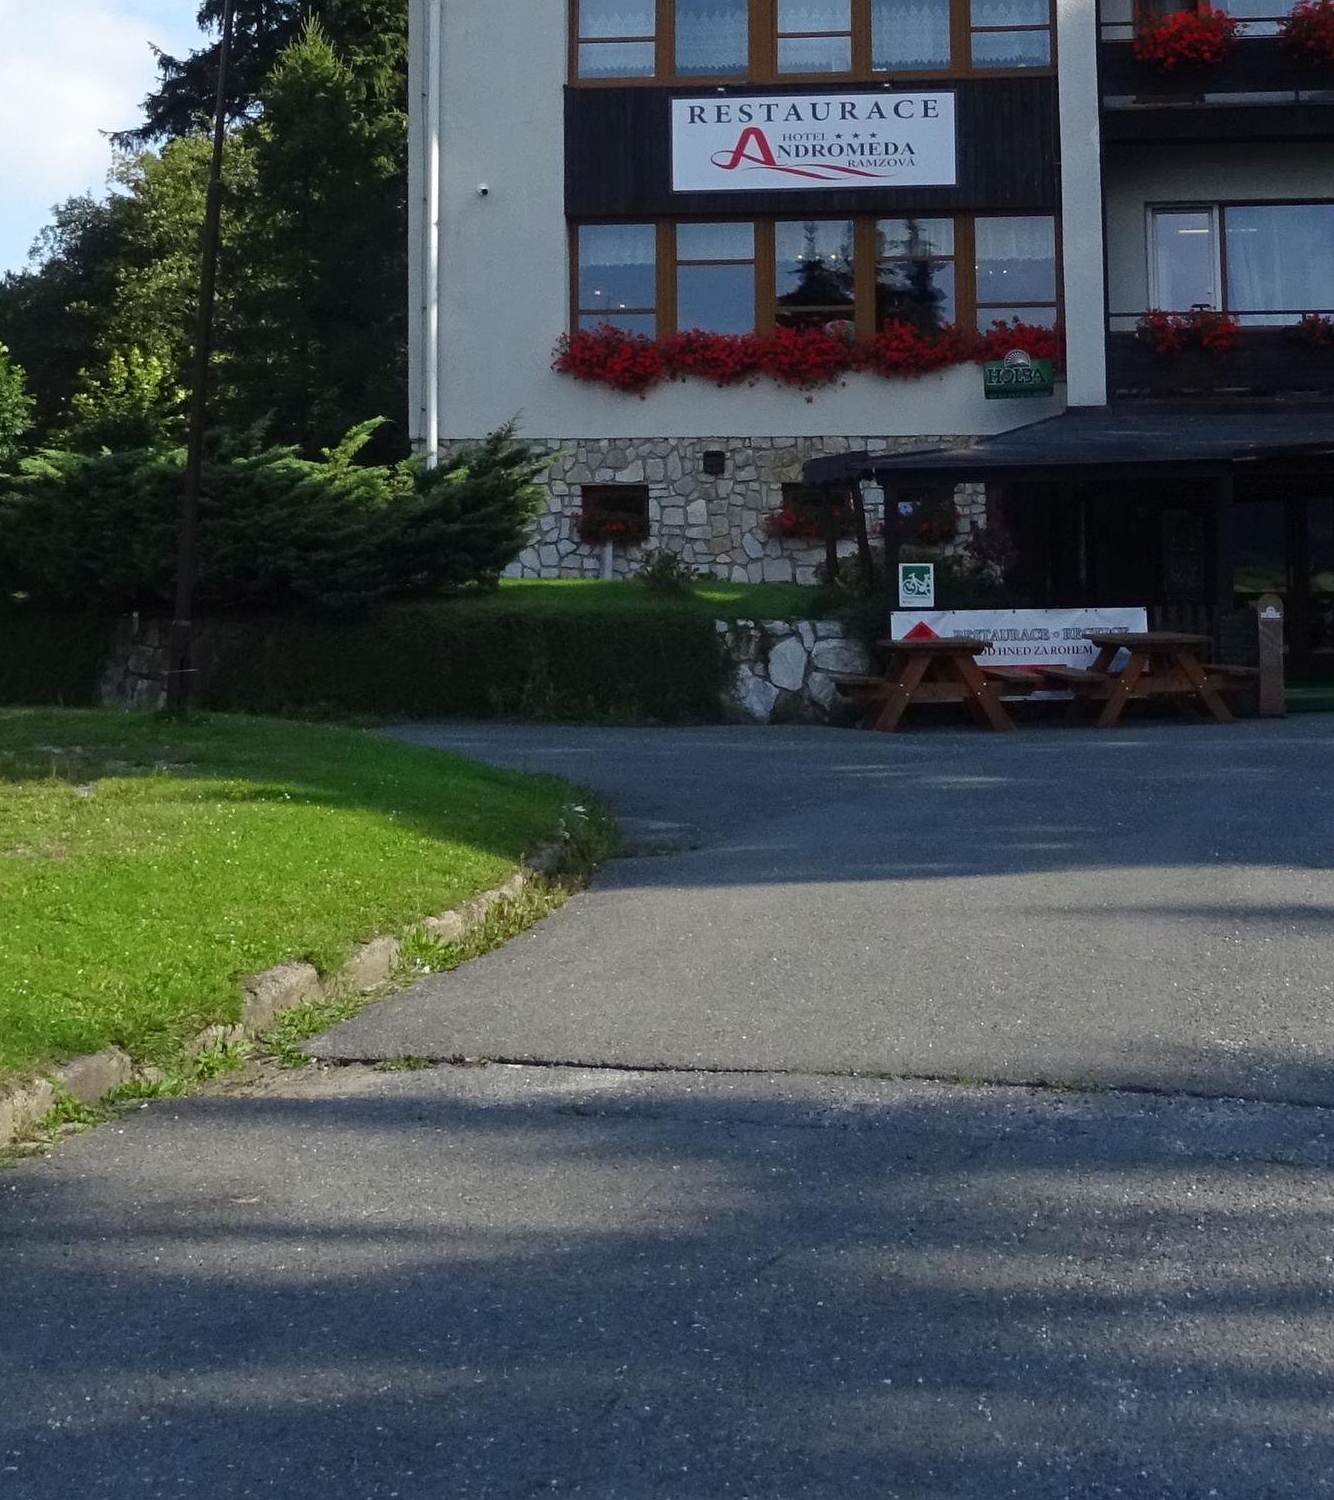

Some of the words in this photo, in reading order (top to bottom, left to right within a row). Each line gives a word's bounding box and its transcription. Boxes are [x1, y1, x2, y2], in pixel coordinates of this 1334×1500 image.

[688, 99, 940, 124] RESTAURACE
[782, 132, 829, 142] HOTEL
[717, 127, 916, 169] ANDROMEDA
[986, 367, 1046, 385] HOLBA
[998, 646, 1032, 656] HNED
[1050, 645, 1093, 655] ROHEM
